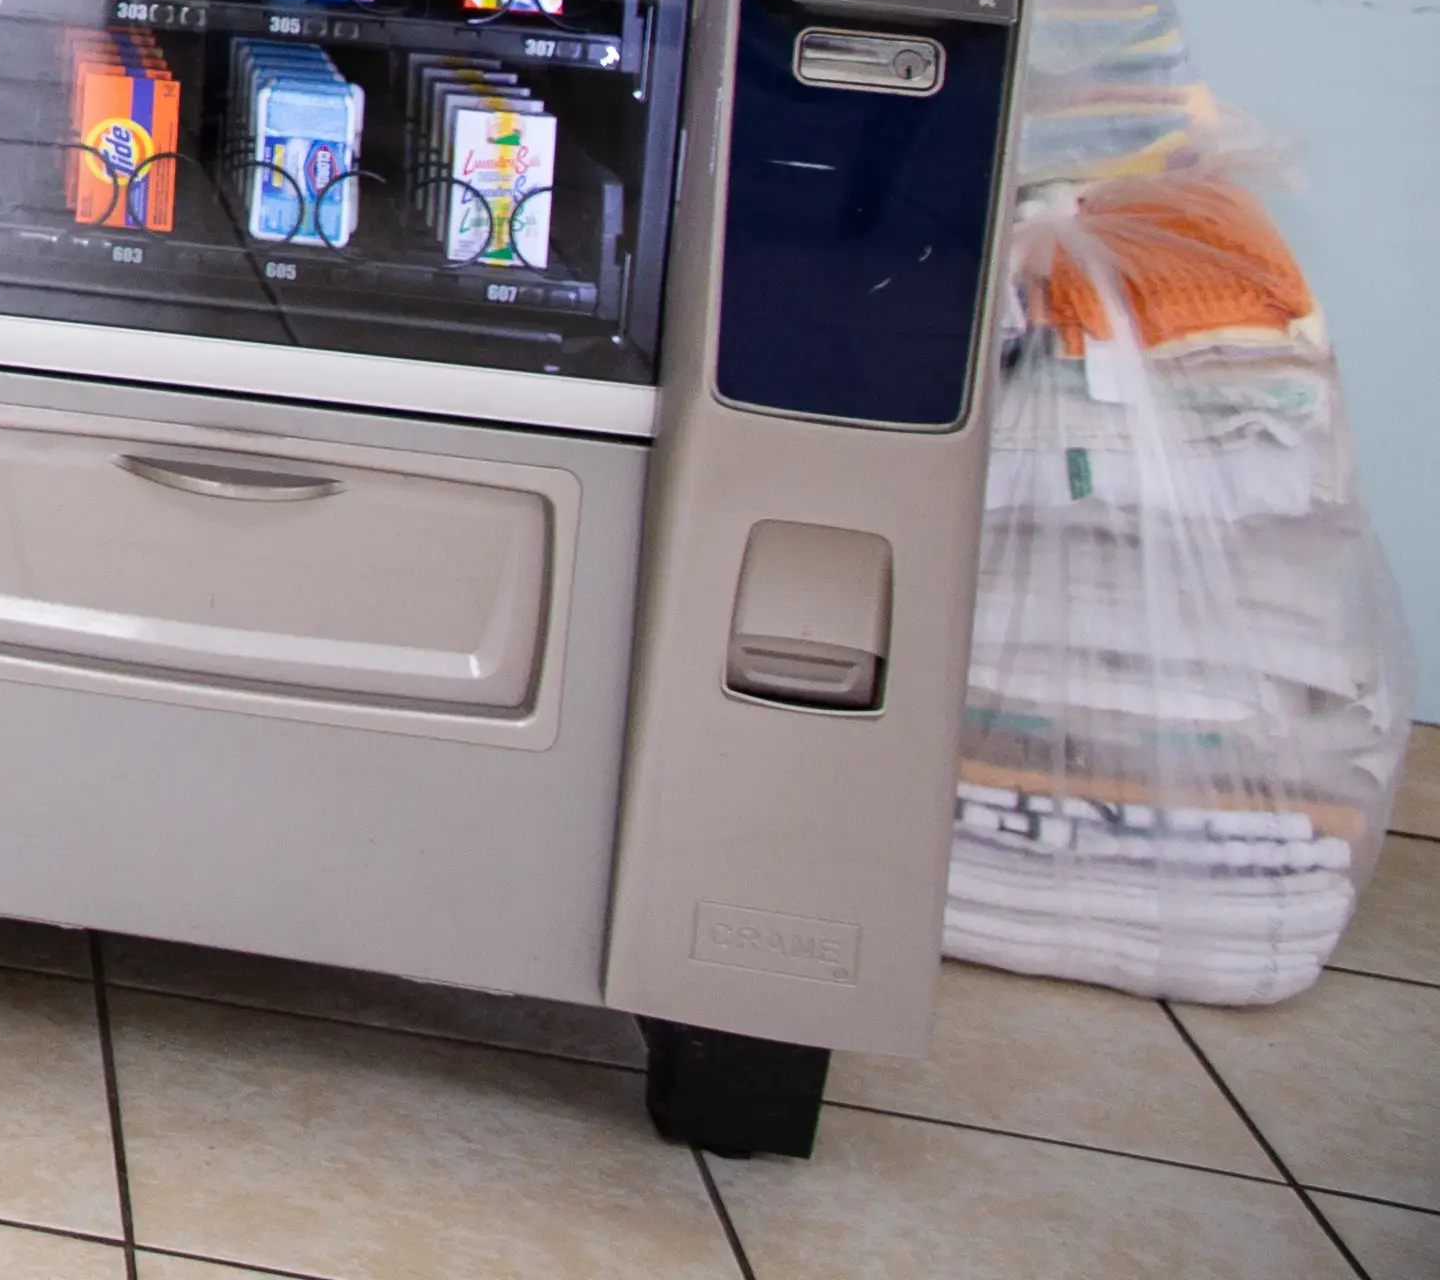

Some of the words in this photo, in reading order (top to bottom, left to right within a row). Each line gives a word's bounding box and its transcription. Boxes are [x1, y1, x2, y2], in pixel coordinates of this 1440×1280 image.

[118, 3, 147, 20] 303
[270, 17, 300, 34] 305
[102, 125, 135, 180] Tide
[112, 247, 143, 264] 603
[712, 922, 842, 964] CRANE
